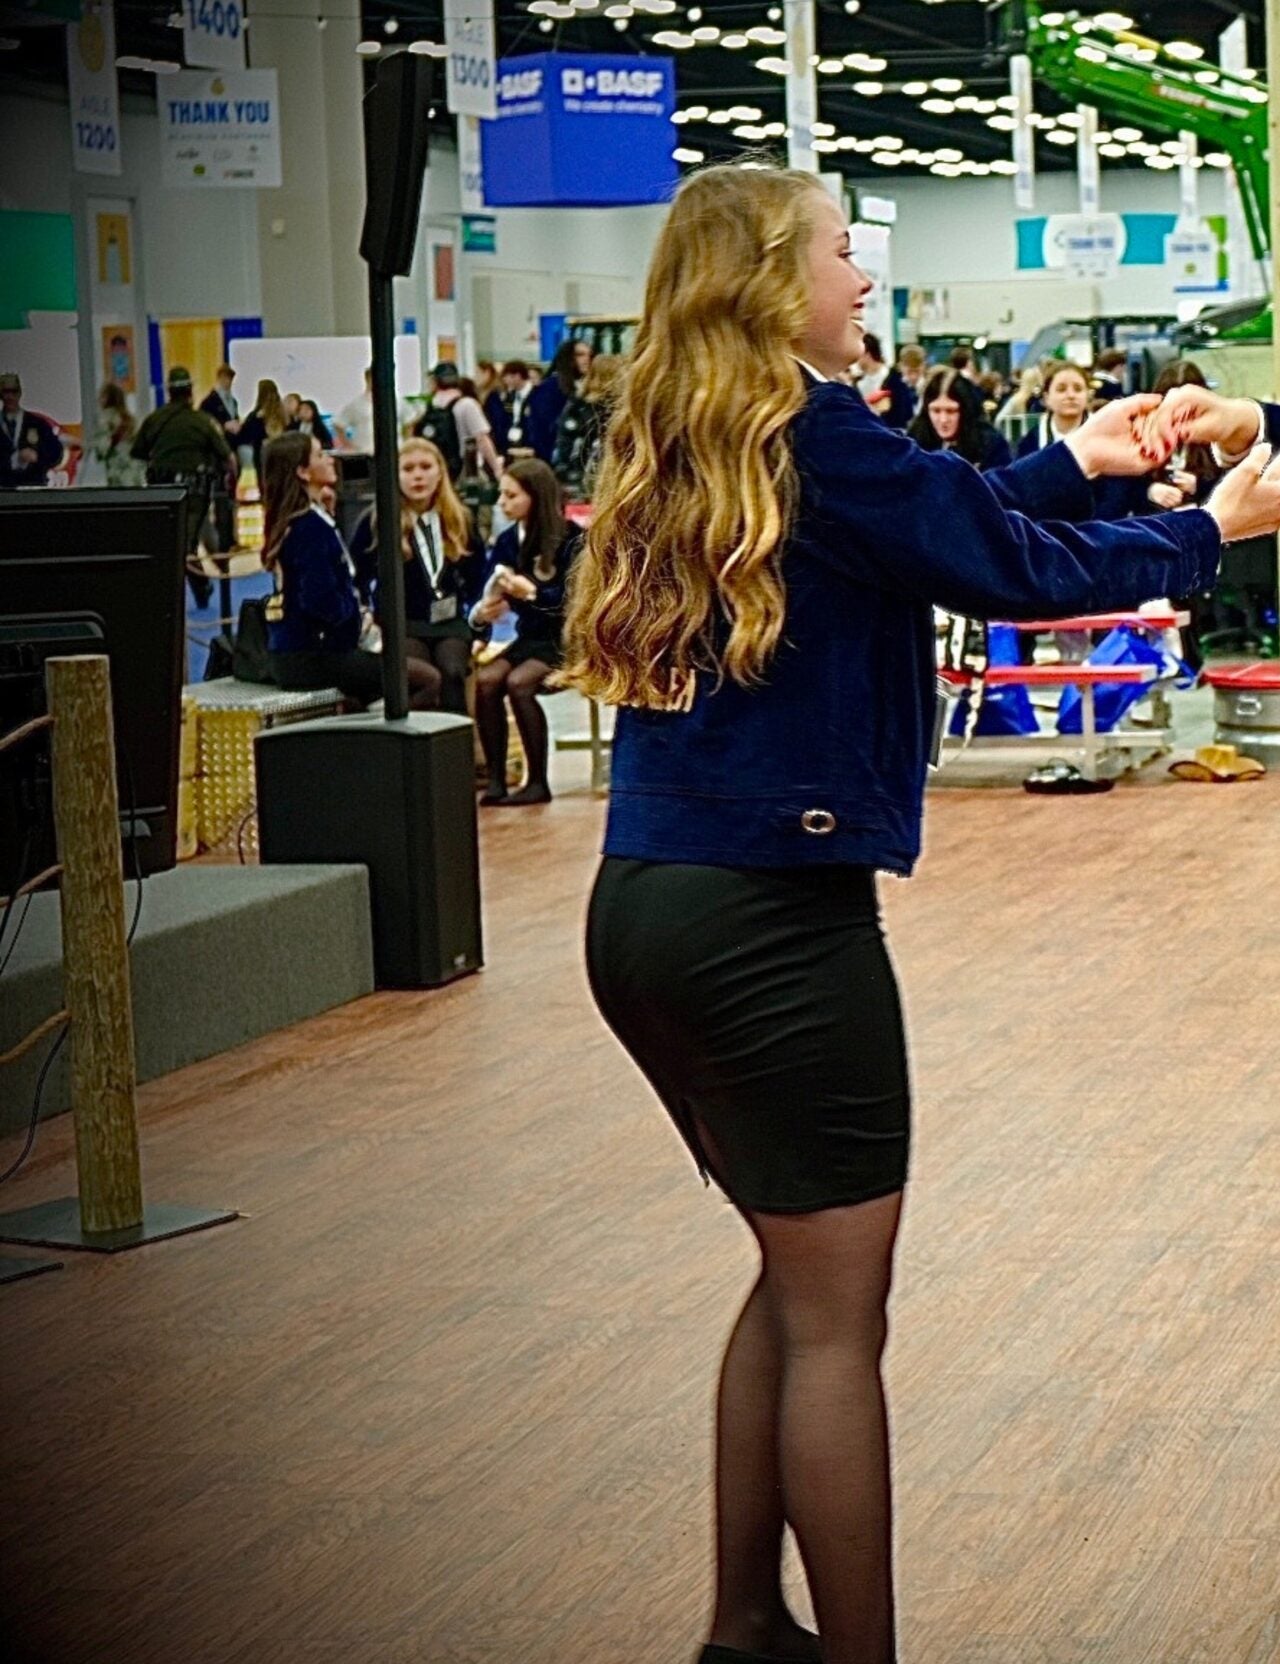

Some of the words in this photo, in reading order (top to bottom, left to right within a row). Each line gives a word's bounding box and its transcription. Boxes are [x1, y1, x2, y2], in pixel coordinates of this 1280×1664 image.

[188, 0, 241, 40] 1400
[596, 70, 664, 97] BASF
[168, 101, 229, 125] THANK
[234, 101, 270, 124] YOU
[77, 121, 116, 151] 1200
